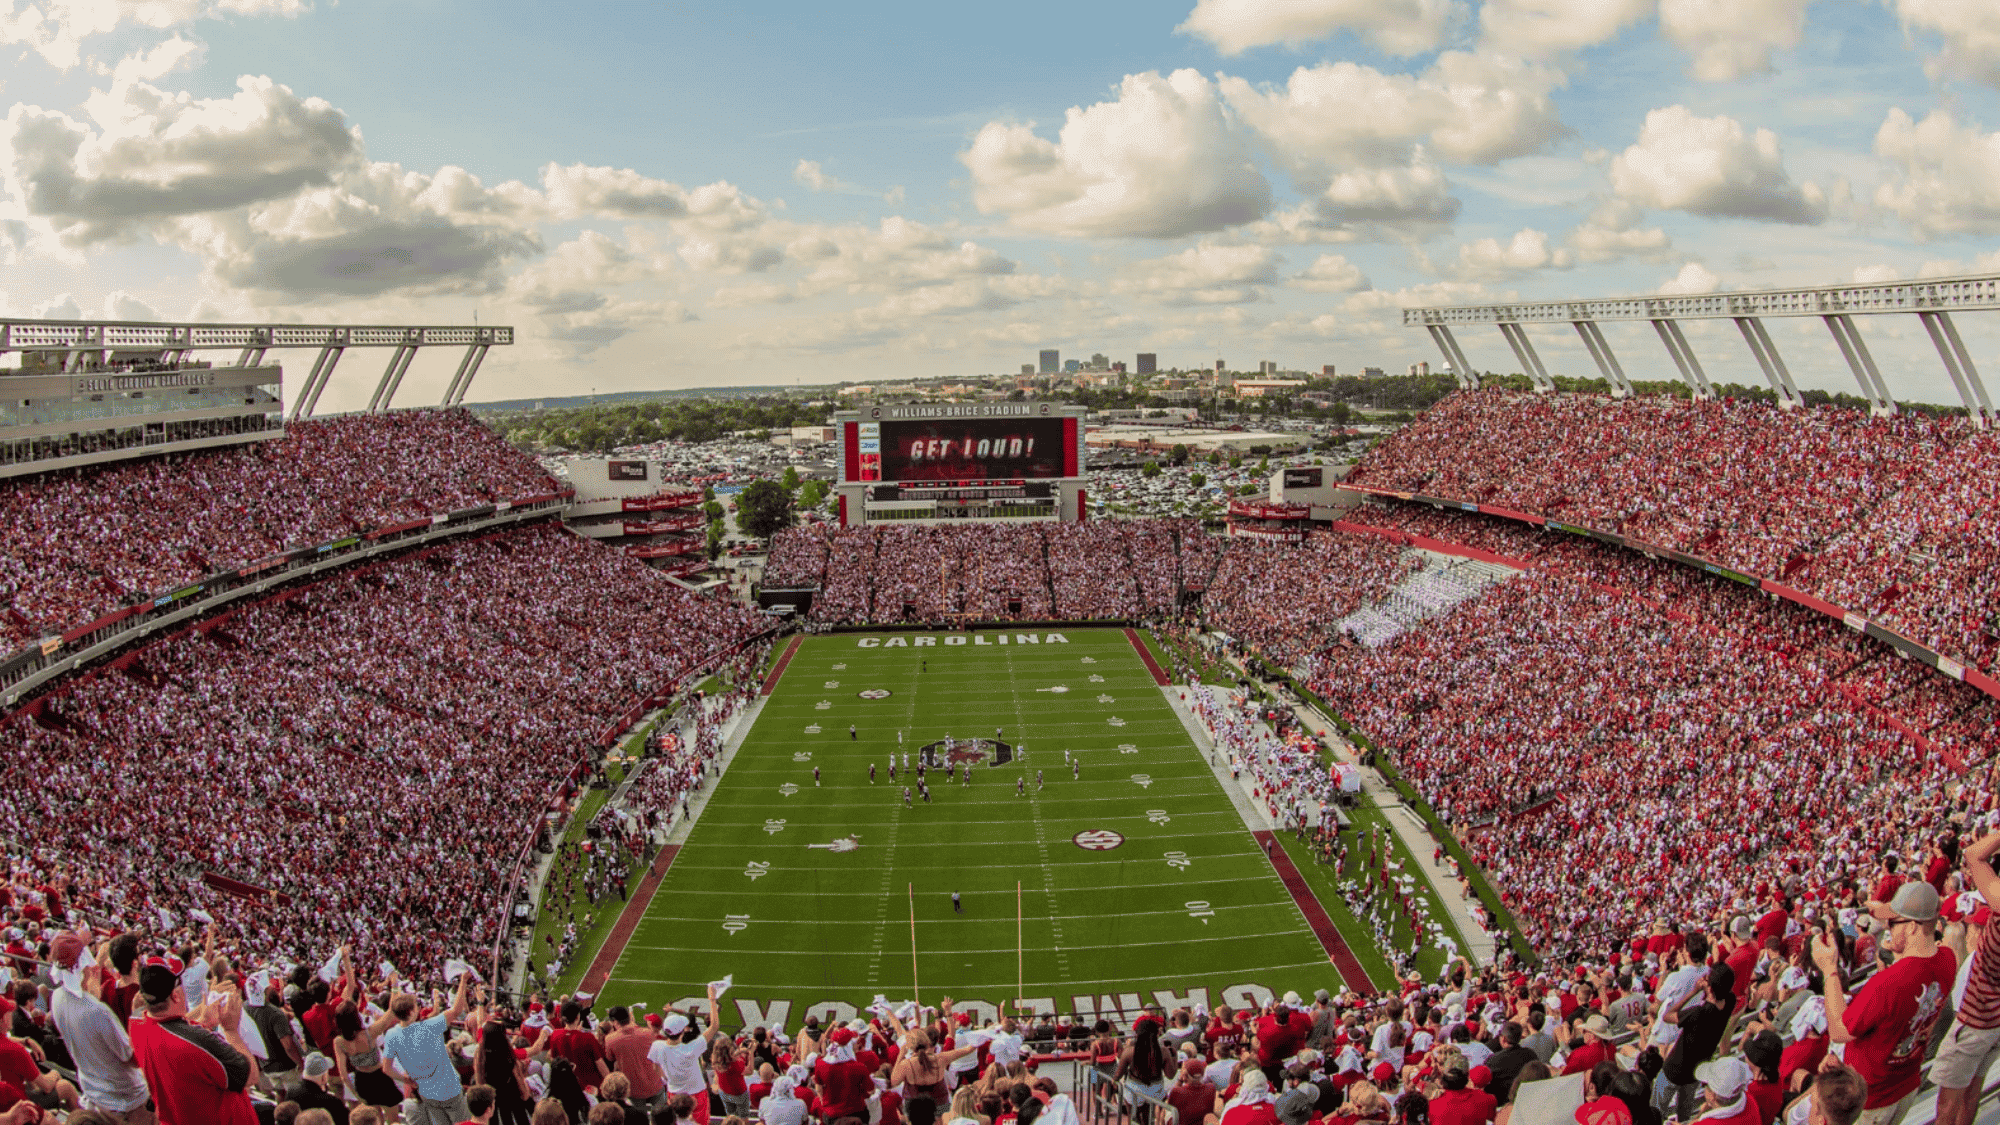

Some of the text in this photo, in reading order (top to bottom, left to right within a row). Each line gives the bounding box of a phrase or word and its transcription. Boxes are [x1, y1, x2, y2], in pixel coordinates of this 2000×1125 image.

[983, 405, 1030, 416] STADIUM
[910, 438, 1034, 460] GET LOUD!
[857, 633, 1070, 648] CAROLINA
[1185, 900, 1215, 917] 10
[722, 914, 750, 930] 10
